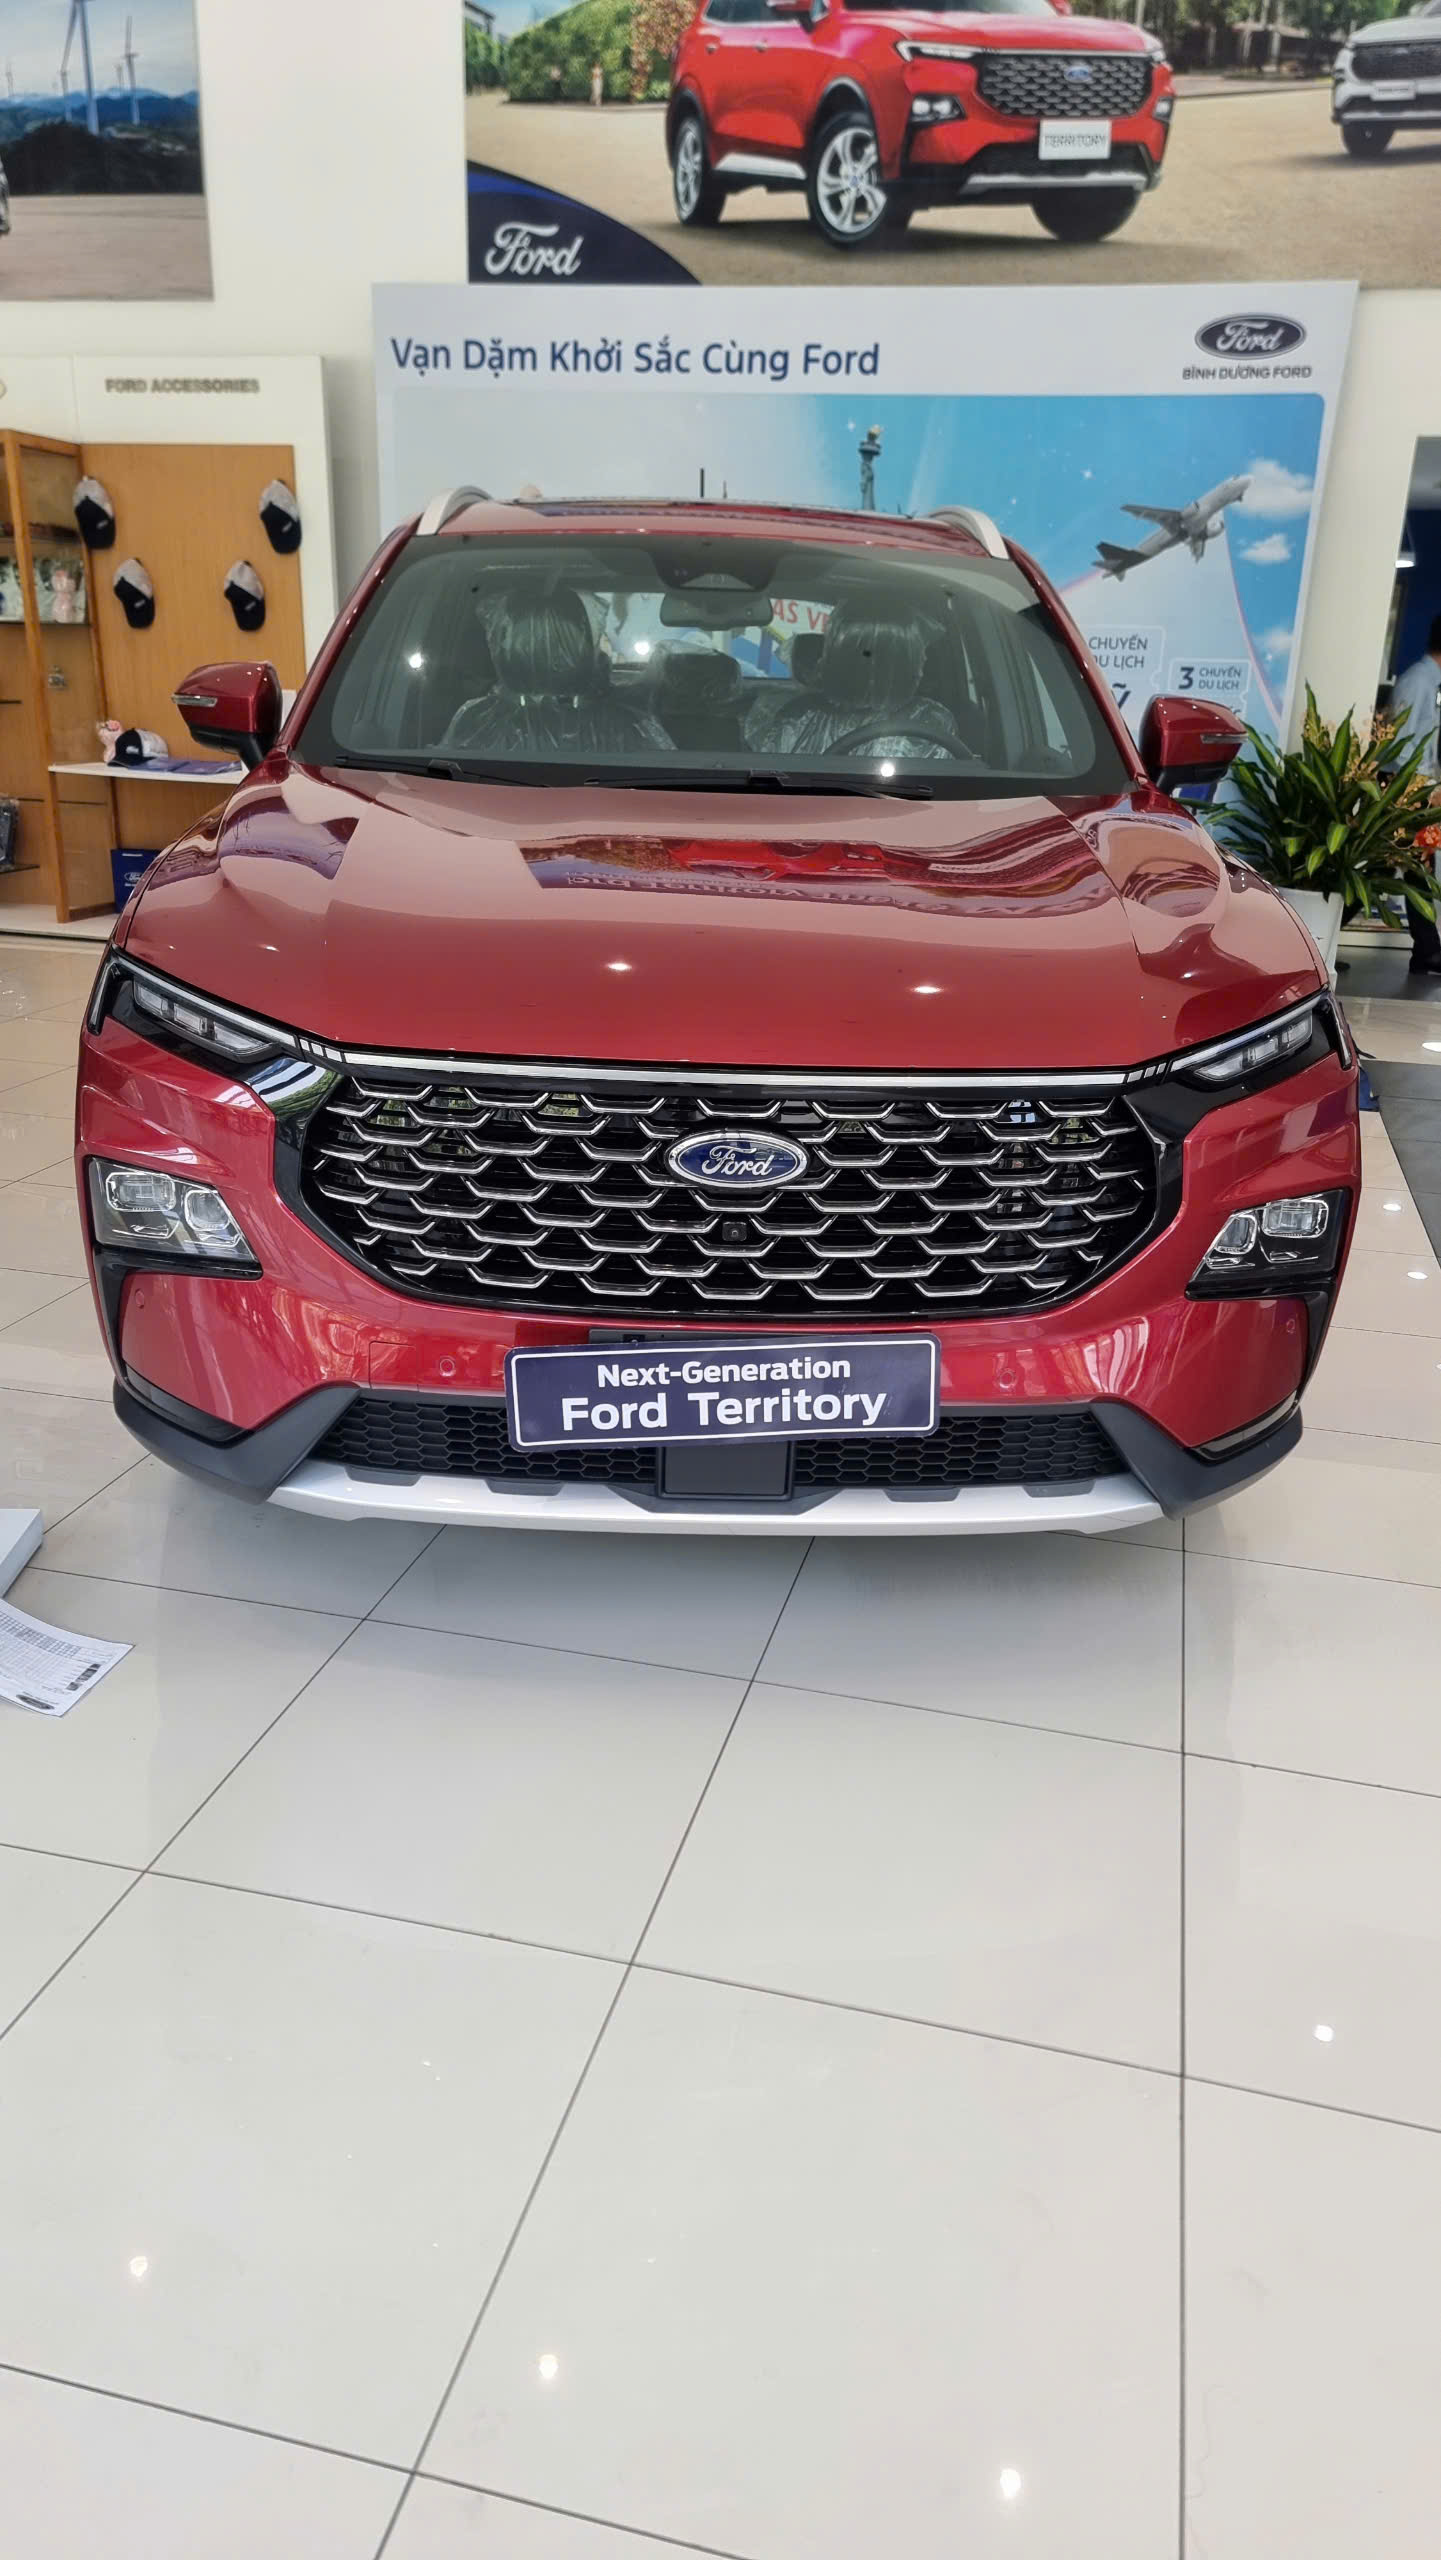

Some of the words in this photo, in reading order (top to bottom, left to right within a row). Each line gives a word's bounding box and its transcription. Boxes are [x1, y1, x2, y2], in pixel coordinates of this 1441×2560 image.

[485, 222, 584, 275] Ford
[1216, 320, 1284, 351] Ford
[391, 337, 450, 377] Vạn
[463, 338, 537, 379] Dặm
[551, 337, 622, 373] Khởi
[633, 335, 690, 374] Sắc
[703, 339, 789, 381] Cùng
[803, 342, 880, 375] Ford
[105, 378, 147, 393] FORD
[151, 378, 260, 393] ACCESSORIES
[1182, 365, 1216, 380] BÌNH
[1272, 365, 1313, 379] FORD
[1088, 634, 1149, 650] CHUYẾN
[1113, 655, 1145, 671] LỊCH
[1178, 666, 1195, 690] 3
[1199, 679, 1215, 690] DU
[701, 1145, 775, 1176] Ford
[597, 1357, 851, 1388] Next-Generation
[562, 1393, 667, 1431] Ford
[687, 1388, 888, 1425] Territory
